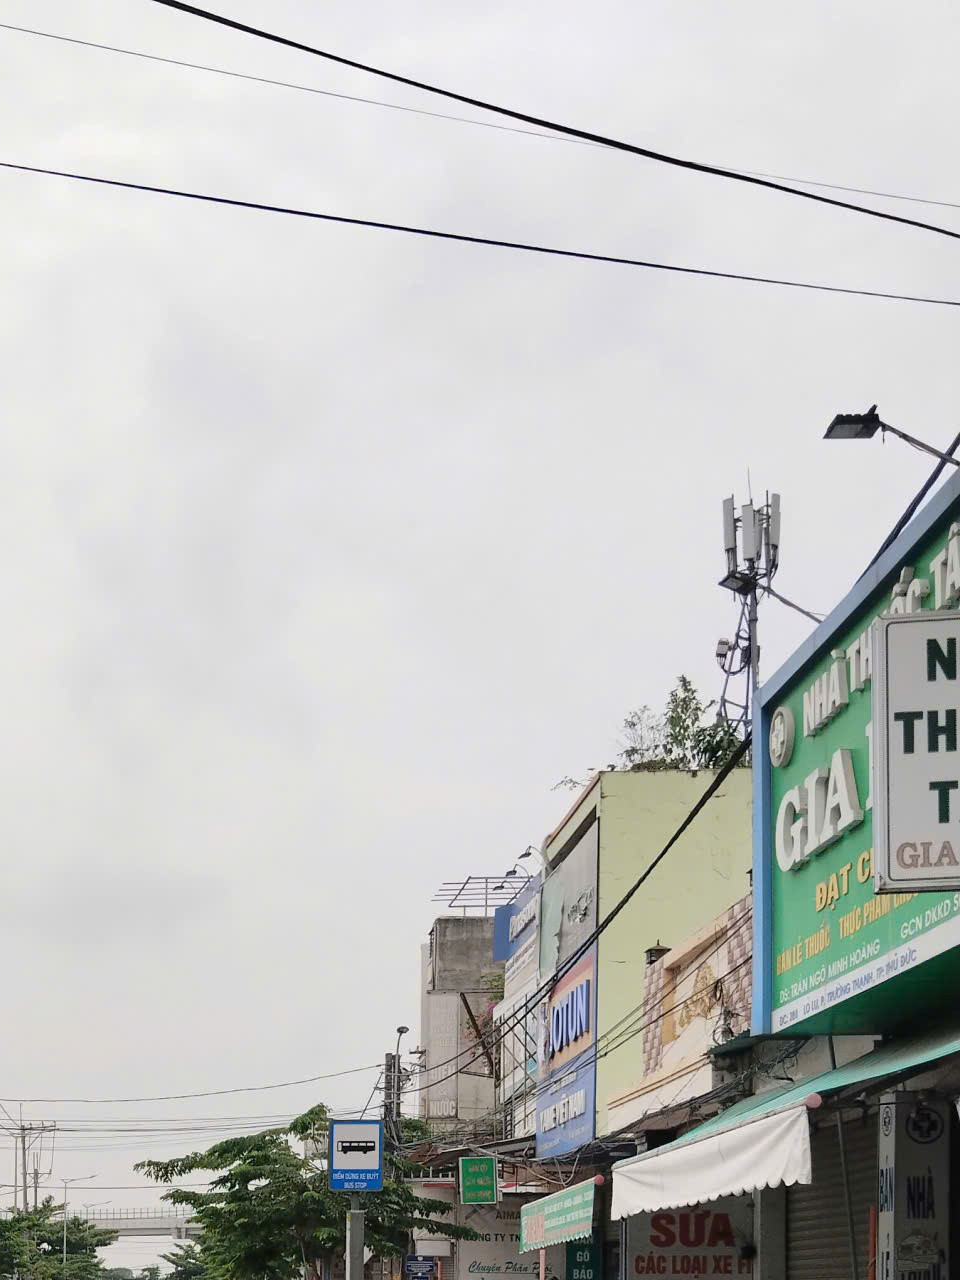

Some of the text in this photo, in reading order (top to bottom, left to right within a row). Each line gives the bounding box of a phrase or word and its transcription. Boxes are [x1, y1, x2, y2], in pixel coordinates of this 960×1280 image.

[926, 637, 957, 682] N
[803, 649, 849, 737] NHÀ
[894, 709, 957, 754] TH
[775, 749, 864, 872] GIA
[929, 780, 959, 824] T
[896, 841, 960, 870] GIA
[900, 914, 923, 938] GCN
[827, 955, 848, 982] MINH
[549, 979, 591, 1060] JOTUN
[906, 1166, 936, 1220] NHÀ
[494, 1233, 506, 1242] TY
[509, 1233, 521, 1242] TN
[635, 1251, 667, 1275] CÁC
[671, 1255, 707, 1279] LOẠI
[712, 1255, 732, 1274] XE
